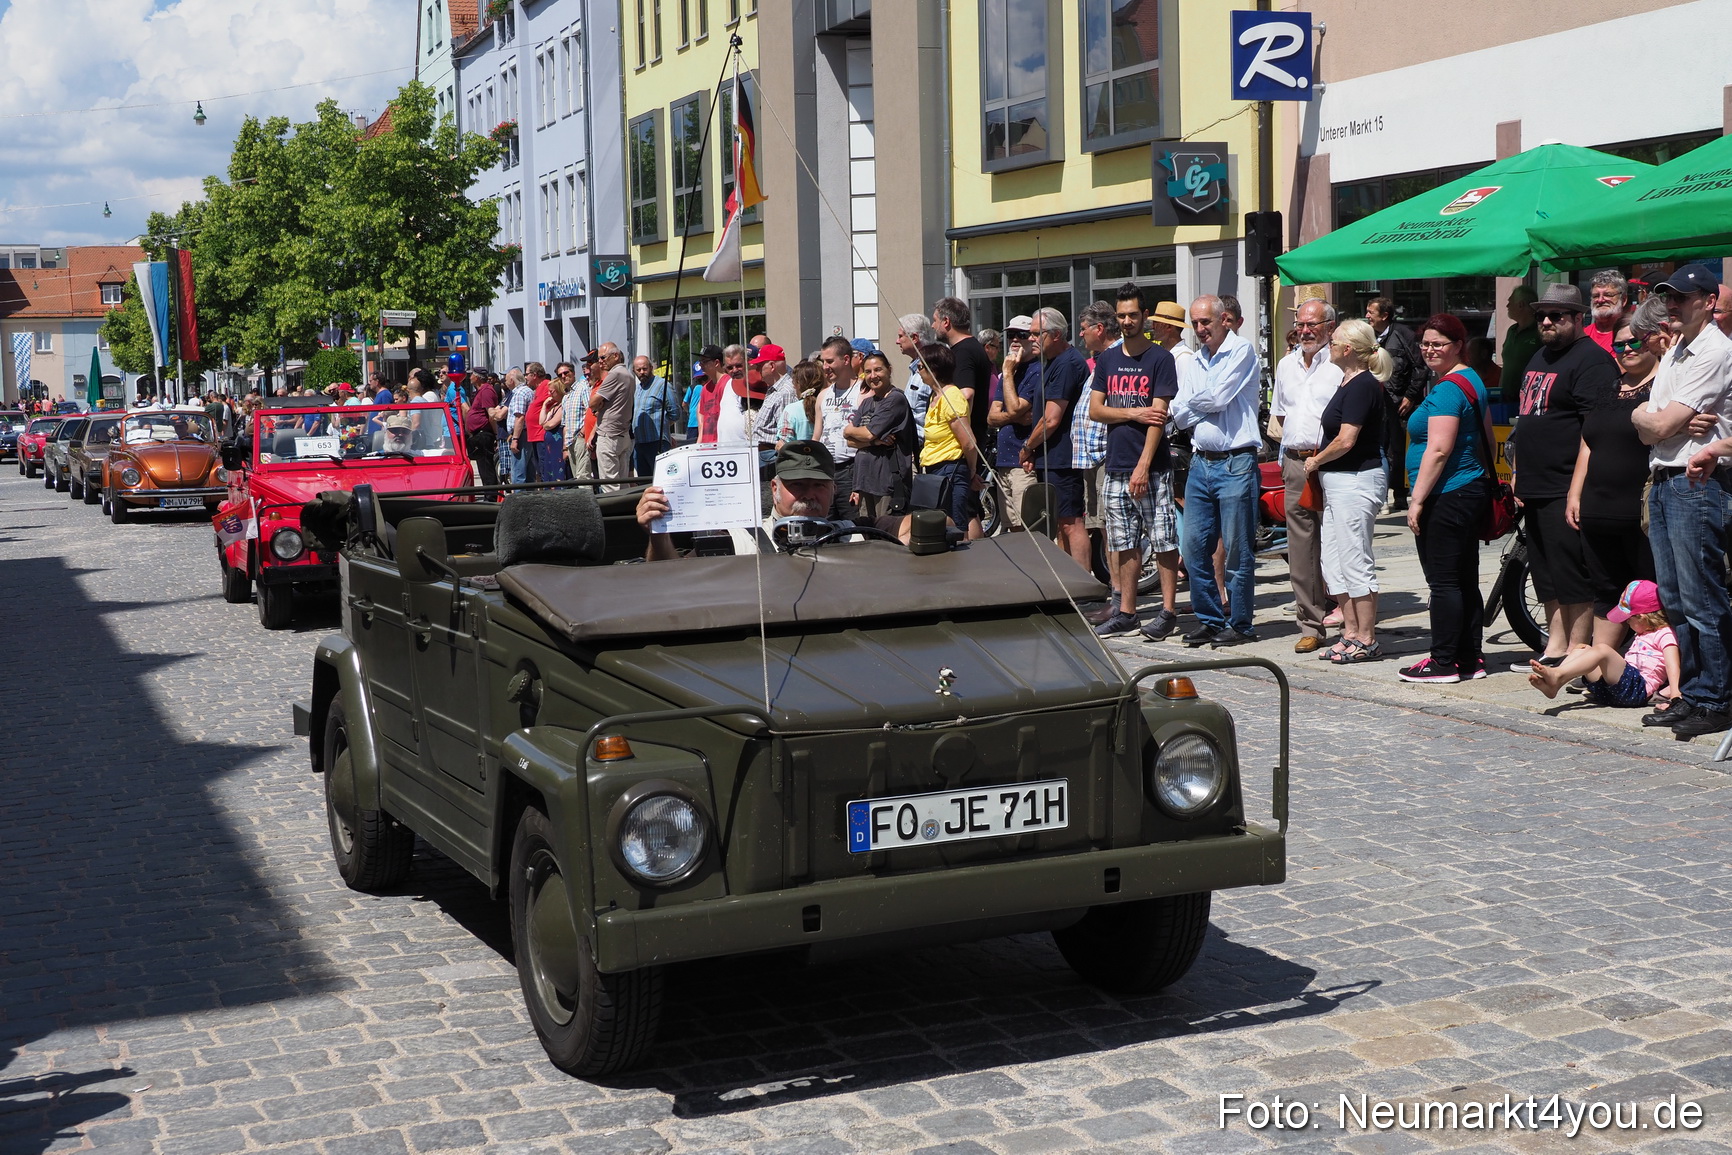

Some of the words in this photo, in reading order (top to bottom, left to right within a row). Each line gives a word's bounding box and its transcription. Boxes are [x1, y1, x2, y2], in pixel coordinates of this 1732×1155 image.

[1320, 126, 1348, 142] Unterer
[1350, 119, 1372, 137] Markt
[1374, 115, 1384, 132] 15
[1184, 164, 1210, 198] G2
[1393, 217, 1477, 231] Neumarkter
[1360, 226, 1473, 245] Lammsbräu
[605, 266, 620, 283] G2
[317, 441, 333, 449] 653
[701, 460, 738, 479] 639
[164, 498, 174, 506] NM
[178, 498, 188, 506] VW
[189, 497, 203, 505] 79H
[871, 803, 918, 843] FO
[944, 794, 991, 834] JE
[1000, 786, 1065, 829] 71H
